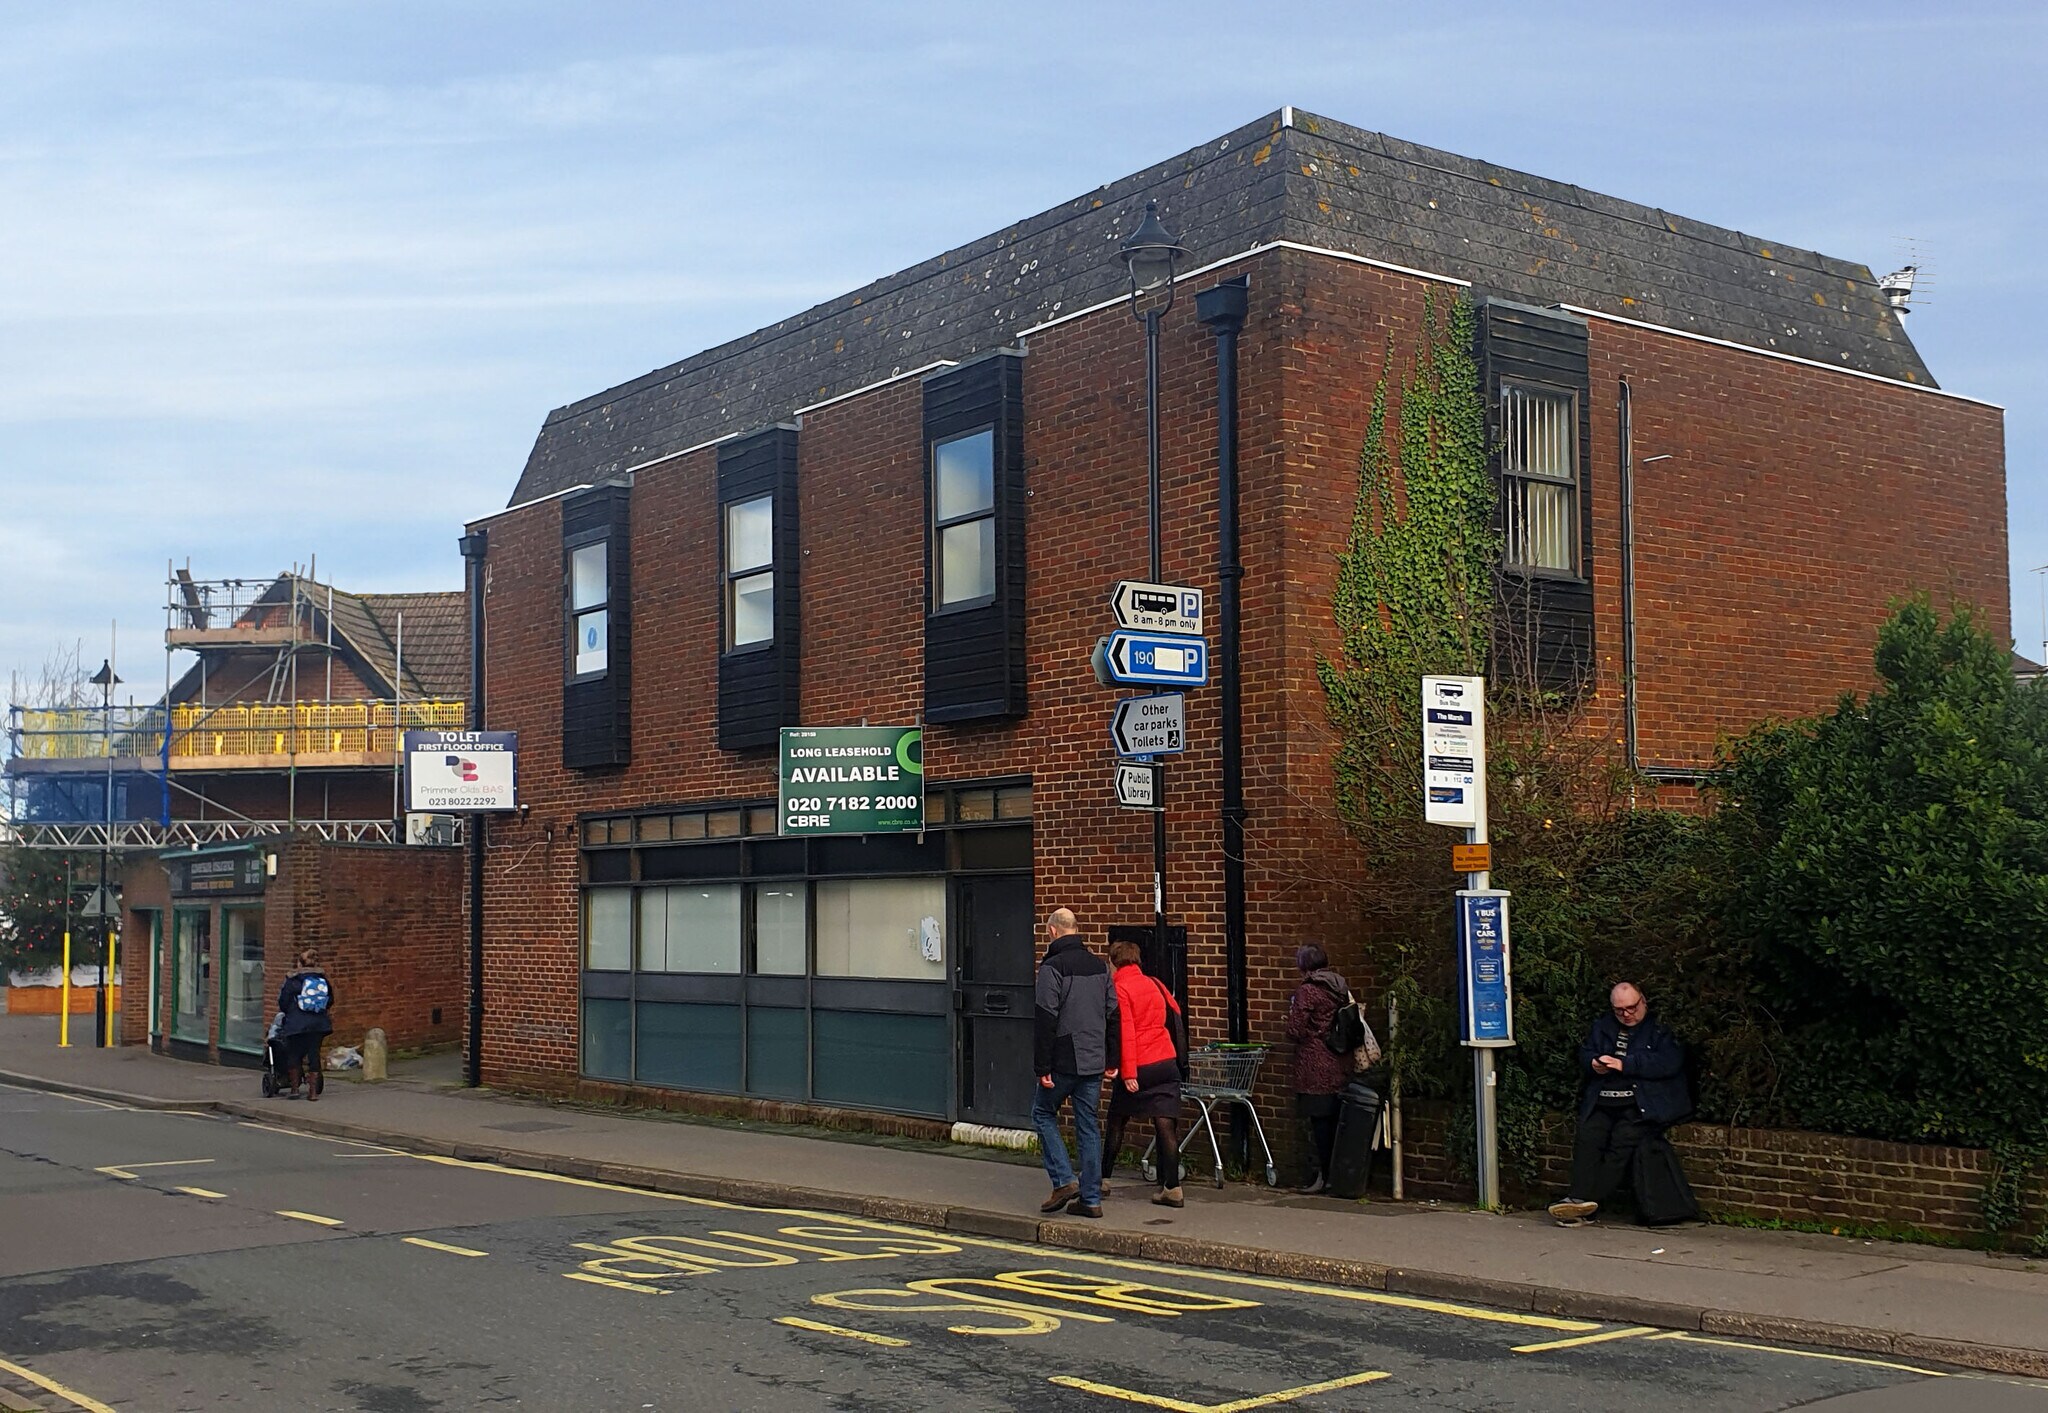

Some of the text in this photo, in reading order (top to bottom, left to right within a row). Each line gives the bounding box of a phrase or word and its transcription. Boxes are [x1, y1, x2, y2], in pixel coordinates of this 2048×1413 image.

[1184, 594, 1197, 616] P
[1134, 615, 1138, 623] 8
[1180, 620, 1196, 630] only
[1134, 648, 1198, 673] 190 P
[1142, 704, 1169, 716] Other
[1134, 718, 1177, 731] car parks
[438, 732, 481, 742] TO LET
[1132, 735, 1164, 748] Toilets
[790, 747, 891, 757] LONG LEASEHOLD
[791, 766, 899, 783] AVAILABLE
[1128, 772, 1150, 784] Public
[420, 785, 504, 794] Primmer Olds BAS
[1128, 786, 1150, 799] library
[429, 797, 496, 806] 023 8022 2292
[788, 796, 917, 811] 020 7182 2000
[787, 815, 830, 827] CBRE
[1475, 909, 1495, 917] 1 BUS
[570, 1226, 962, 1278] STOP
[811, 1270, 1264, 1334] BUS
